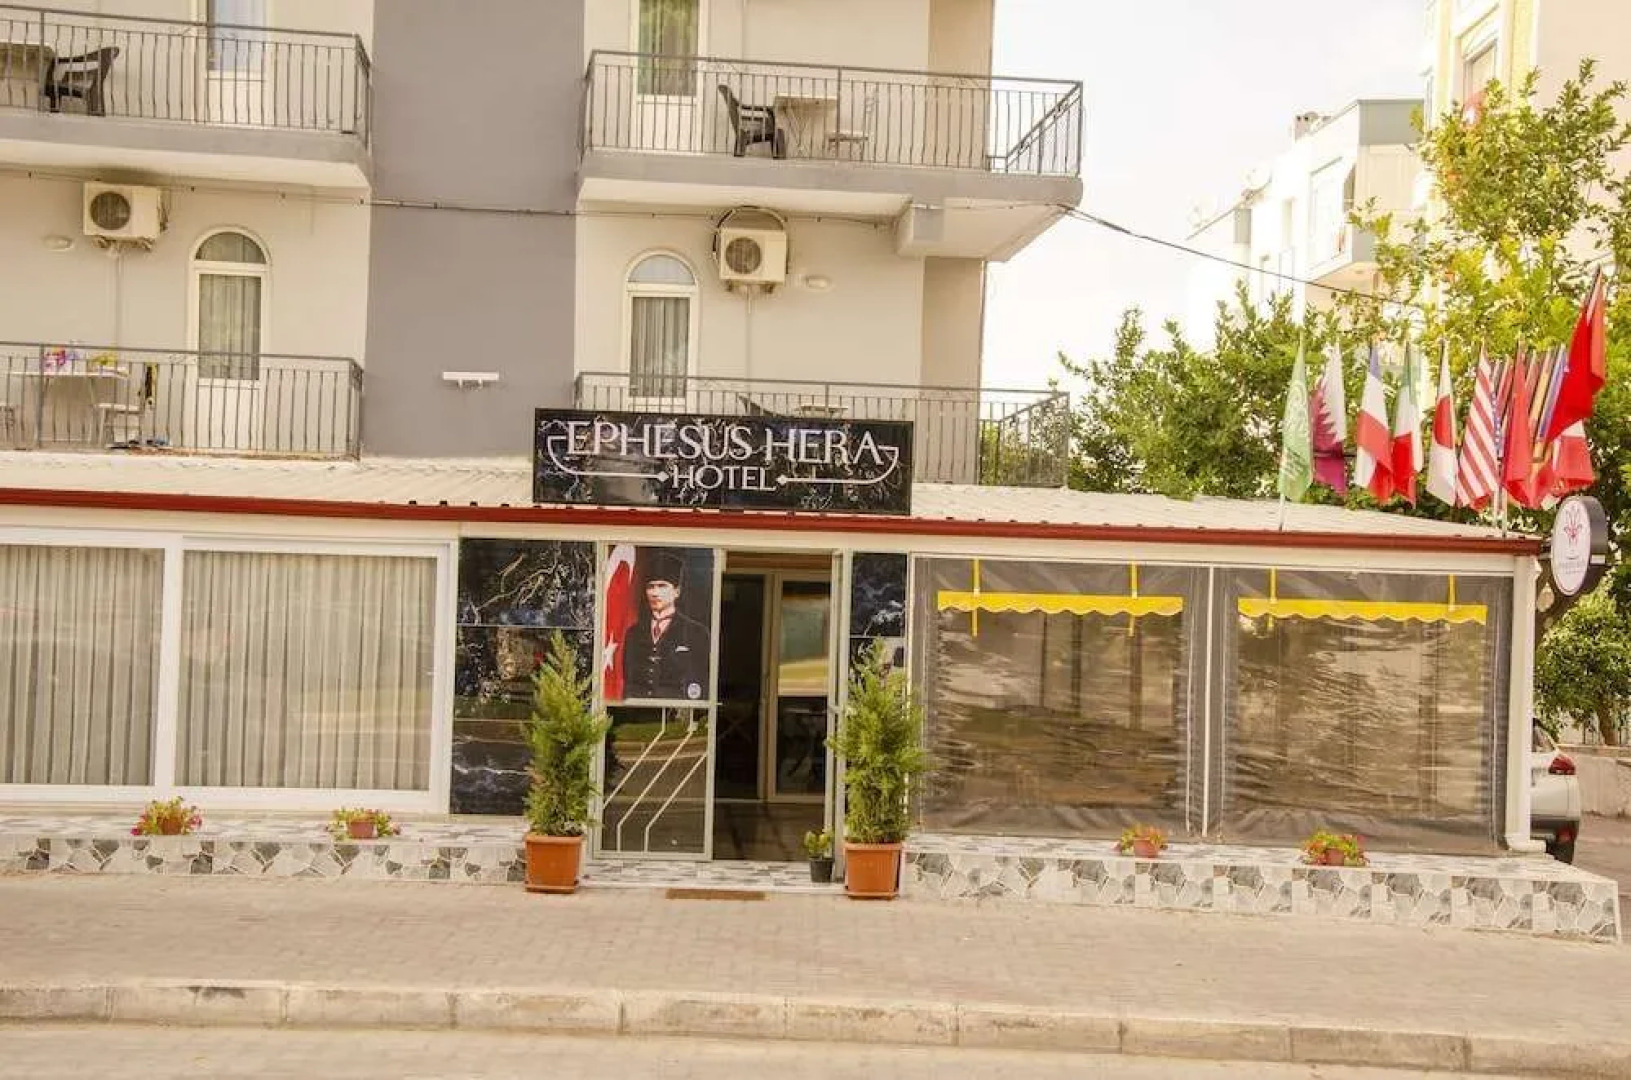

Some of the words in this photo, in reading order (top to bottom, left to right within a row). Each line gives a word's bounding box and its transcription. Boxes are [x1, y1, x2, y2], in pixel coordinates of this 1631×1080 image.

[566, 420, 752, 460] EPHESUS
[765, 427, 885, 466] HERA
[671, 464, 778, 492] HOTEL
